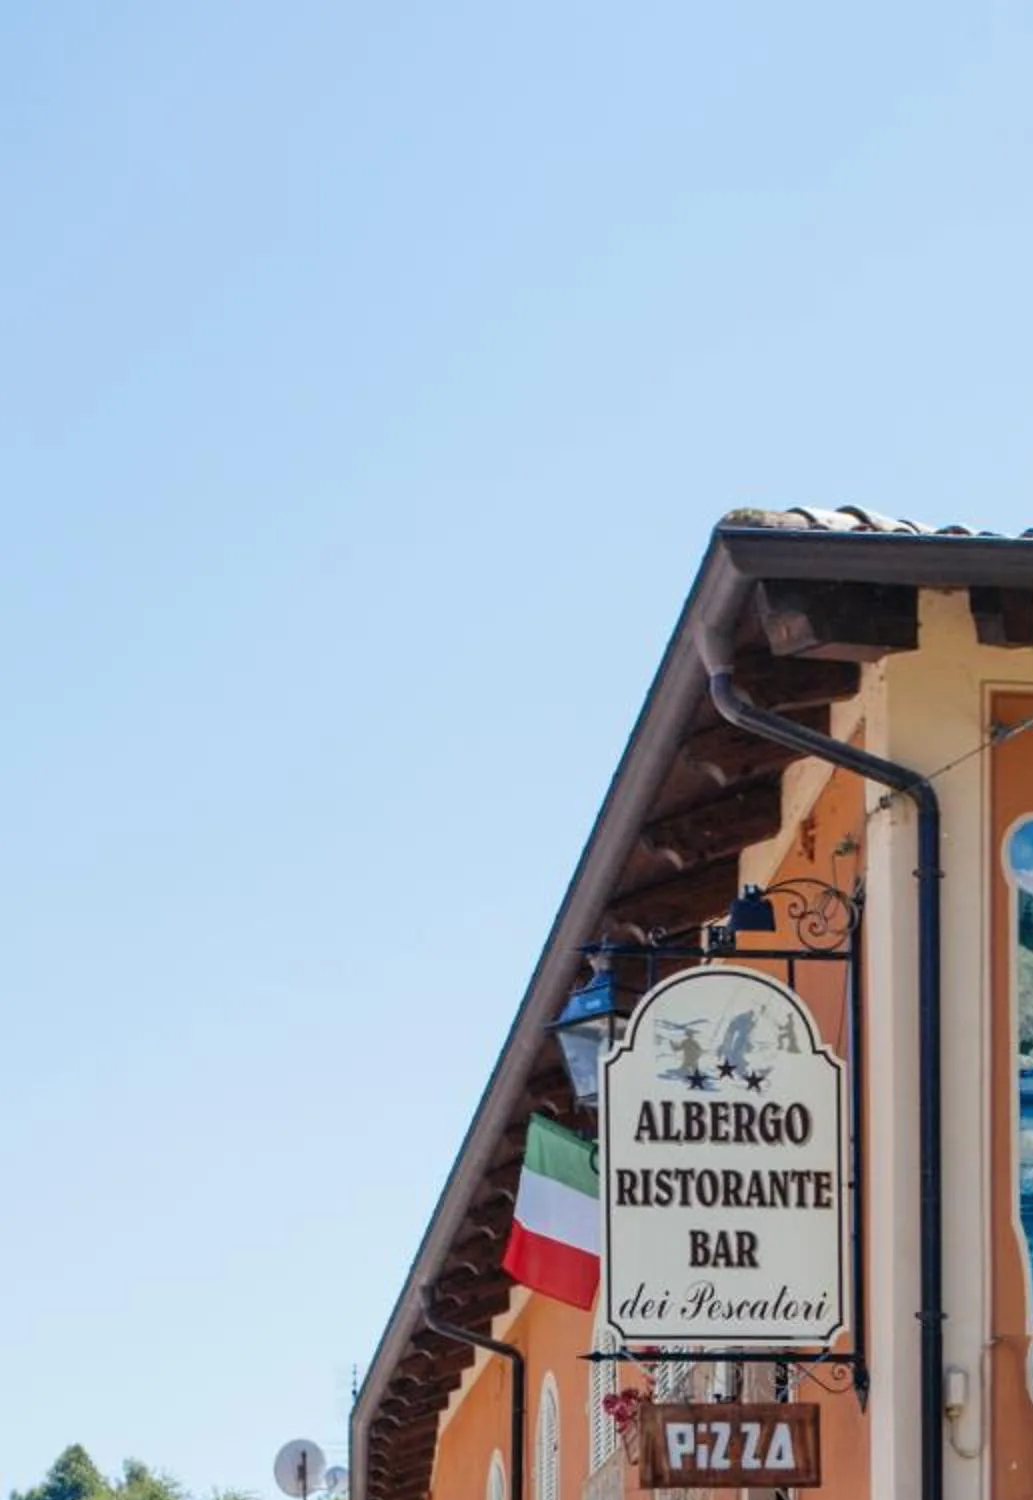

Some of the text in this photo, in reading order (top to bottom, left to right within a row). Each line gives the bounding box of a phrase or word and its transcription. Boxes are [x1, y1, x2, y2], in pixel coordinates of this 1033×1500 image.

[634, 1101, 813, 1145] ALBERGO
[616, 1168, 833, 1209] RISTORANTE
[689, 1229, 760, 1269] BAR
[618, 1279, 828, 1320] dei Pescatori
